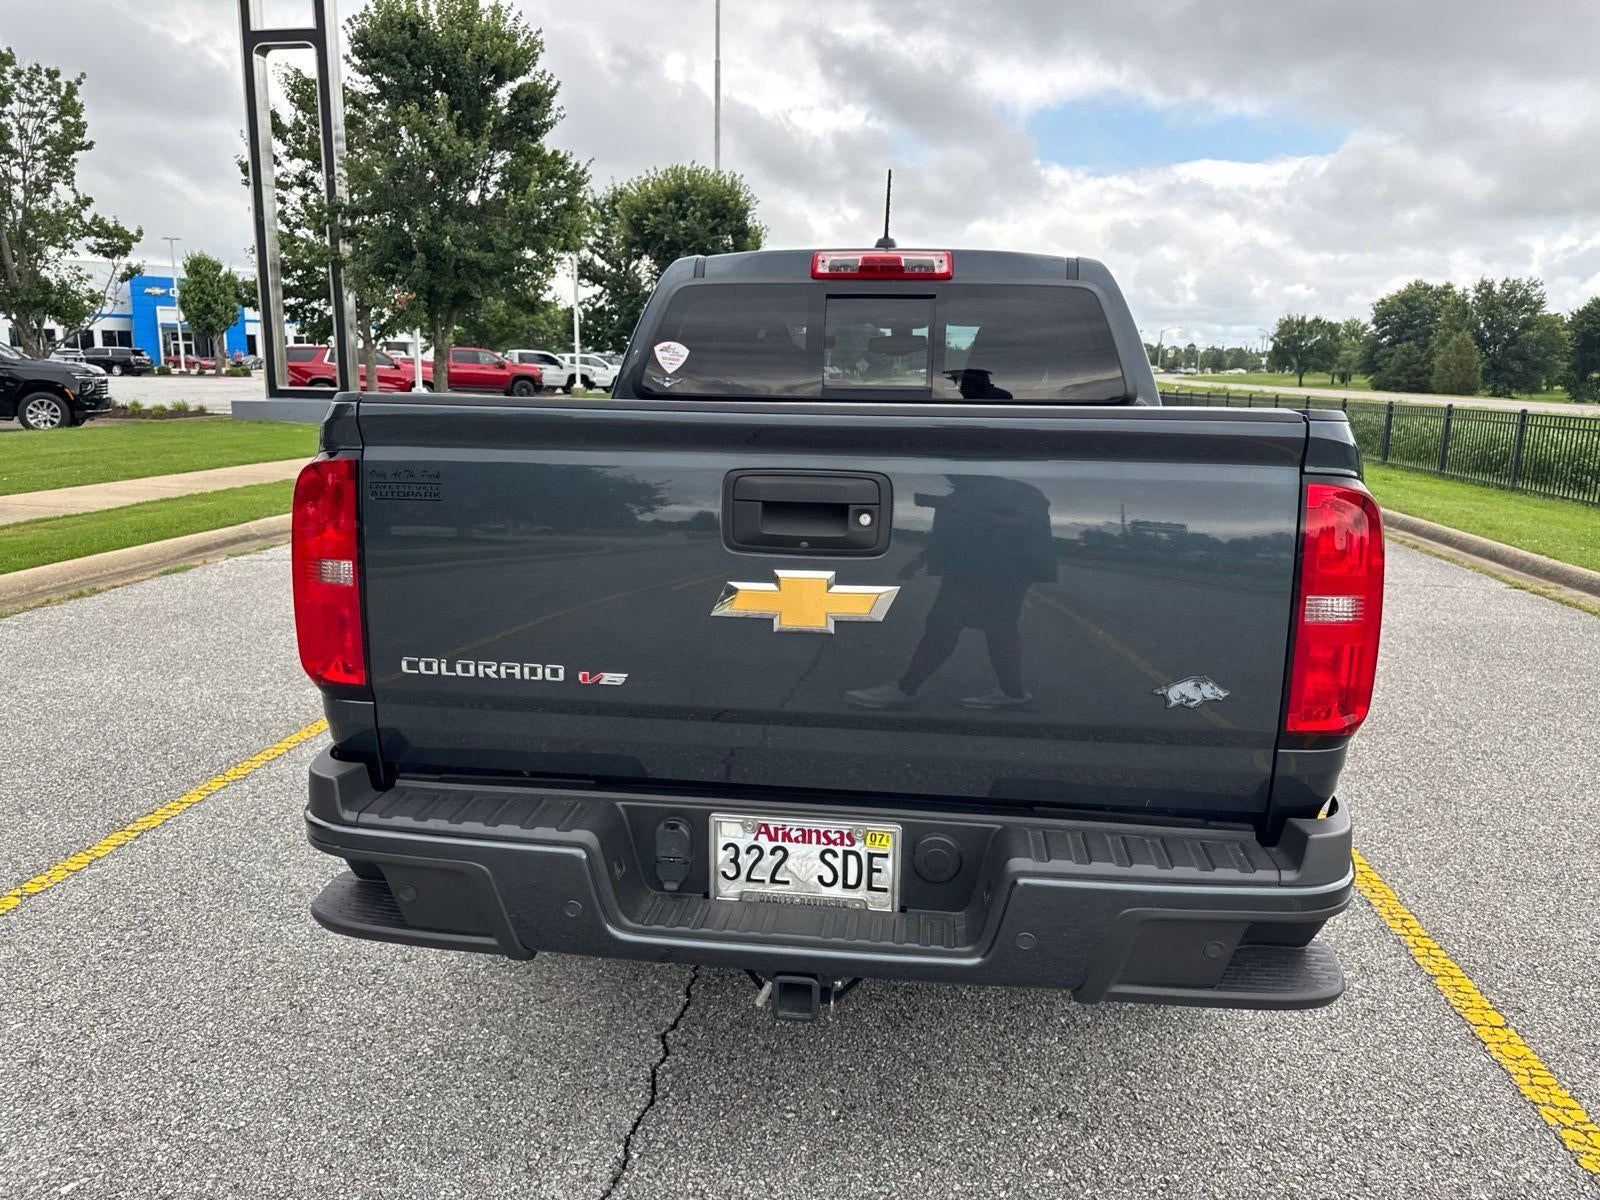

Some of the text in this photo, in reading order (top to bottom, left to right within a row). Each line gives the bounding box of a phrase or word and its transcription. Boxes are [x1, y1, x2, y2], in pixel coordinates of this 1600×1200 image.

[370, 490, 441, 498] AUTOPARK
[401, 656, 629, 686] COLORADO V6
[753, 823, 856, 847] Arkansas
[870, 832, 885, 844] 07
[721, 842, 889, 893] 322 SDE
